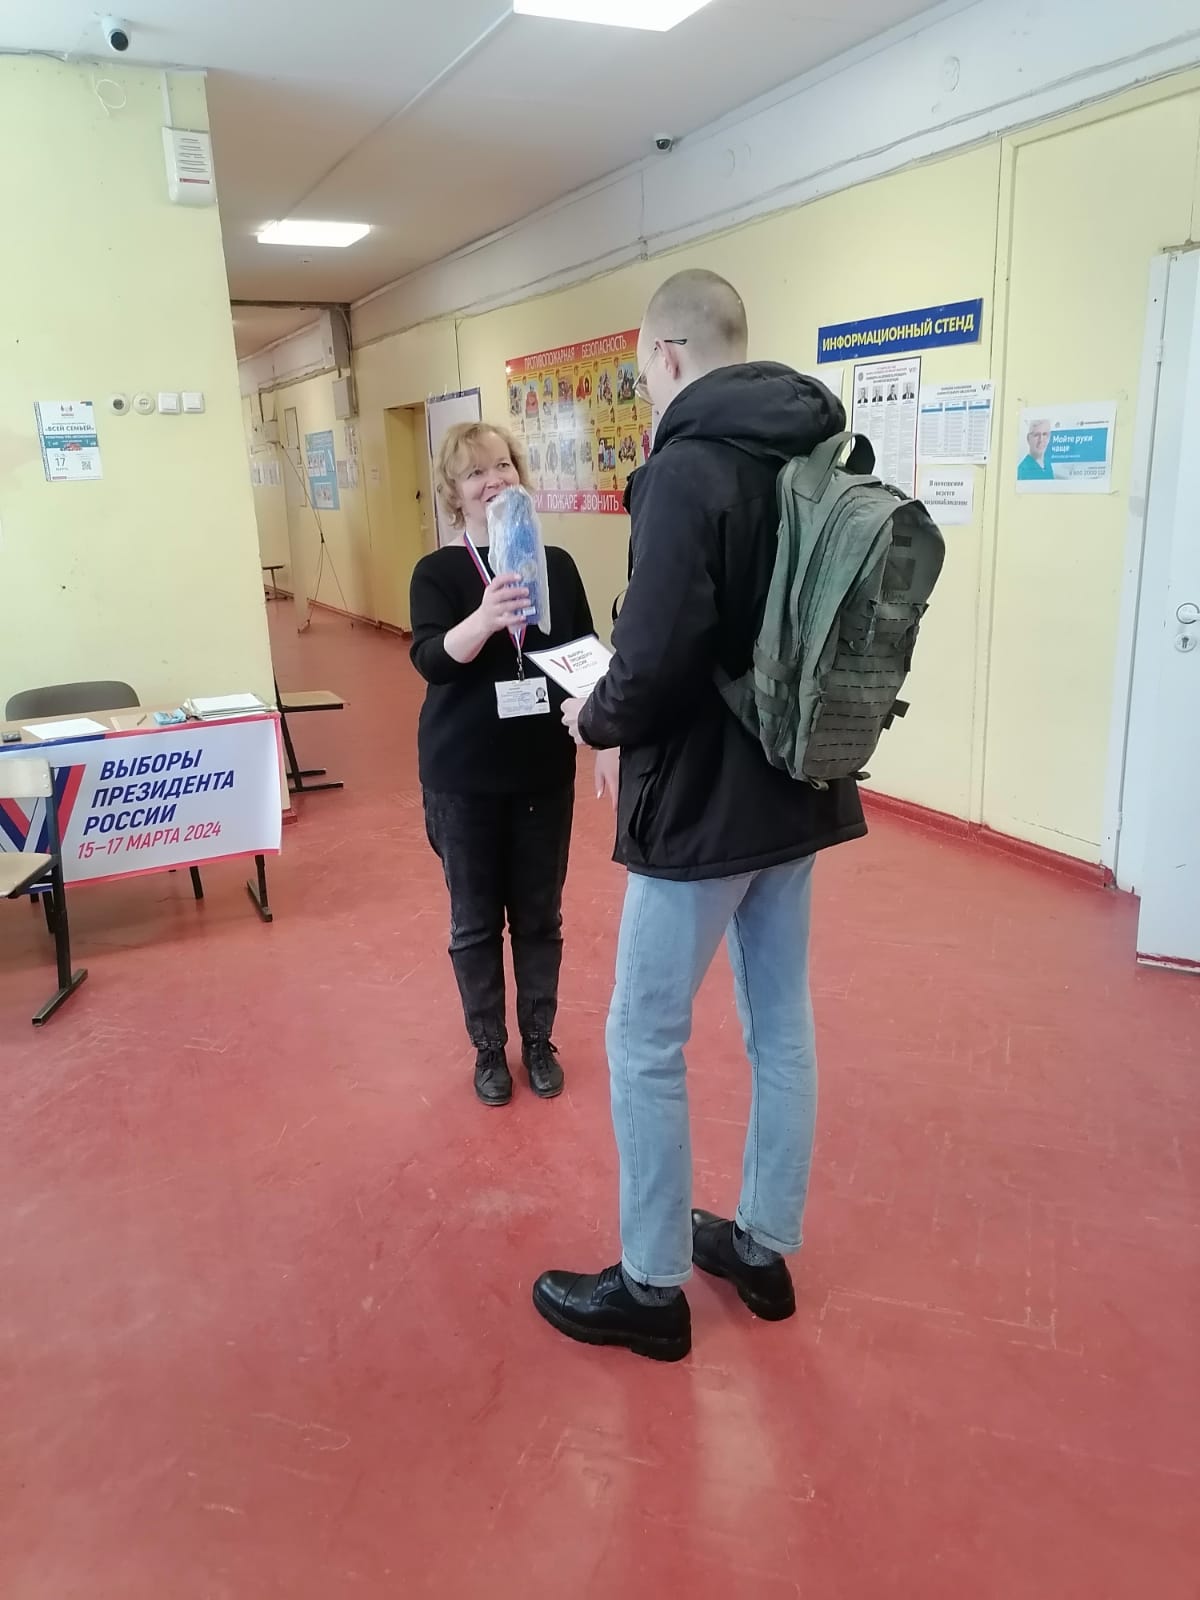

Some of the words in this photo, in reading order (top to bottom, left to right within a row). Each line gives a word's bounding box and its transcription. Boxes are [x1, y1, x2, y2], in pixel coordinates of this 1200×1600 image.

[822, 319, 932, 352] ИНФОРМАЦИОННЫЙ
[934, 313, 974, 335] СТЕНД
[524, 346, 576, 370] ПРОТИВОПОЖАРНАЯ
[581, 335, 627, 359] БЕЗОПАСНОСТЬ
[1051, 445, 1070, 453] чаще
[1052, 435, 1075, 444] Мойте
[1075, 435, 1093, 445] руки
[55, 457, 66, 467] 17
[546, 494, 578, 511] ПОЖАРЕ
[583, 494, 620, 512] ЗВОНИТЬ
[100, 749, 203, 781] ВЫБОРЫ
[91, 770, 235, 809] ПРЕЗИДЕНТА
[83, 803, 177, 836] РОССИИ
[126, 825, 180, 852] МАРТА
[183, 821, 221, 842] 2024
